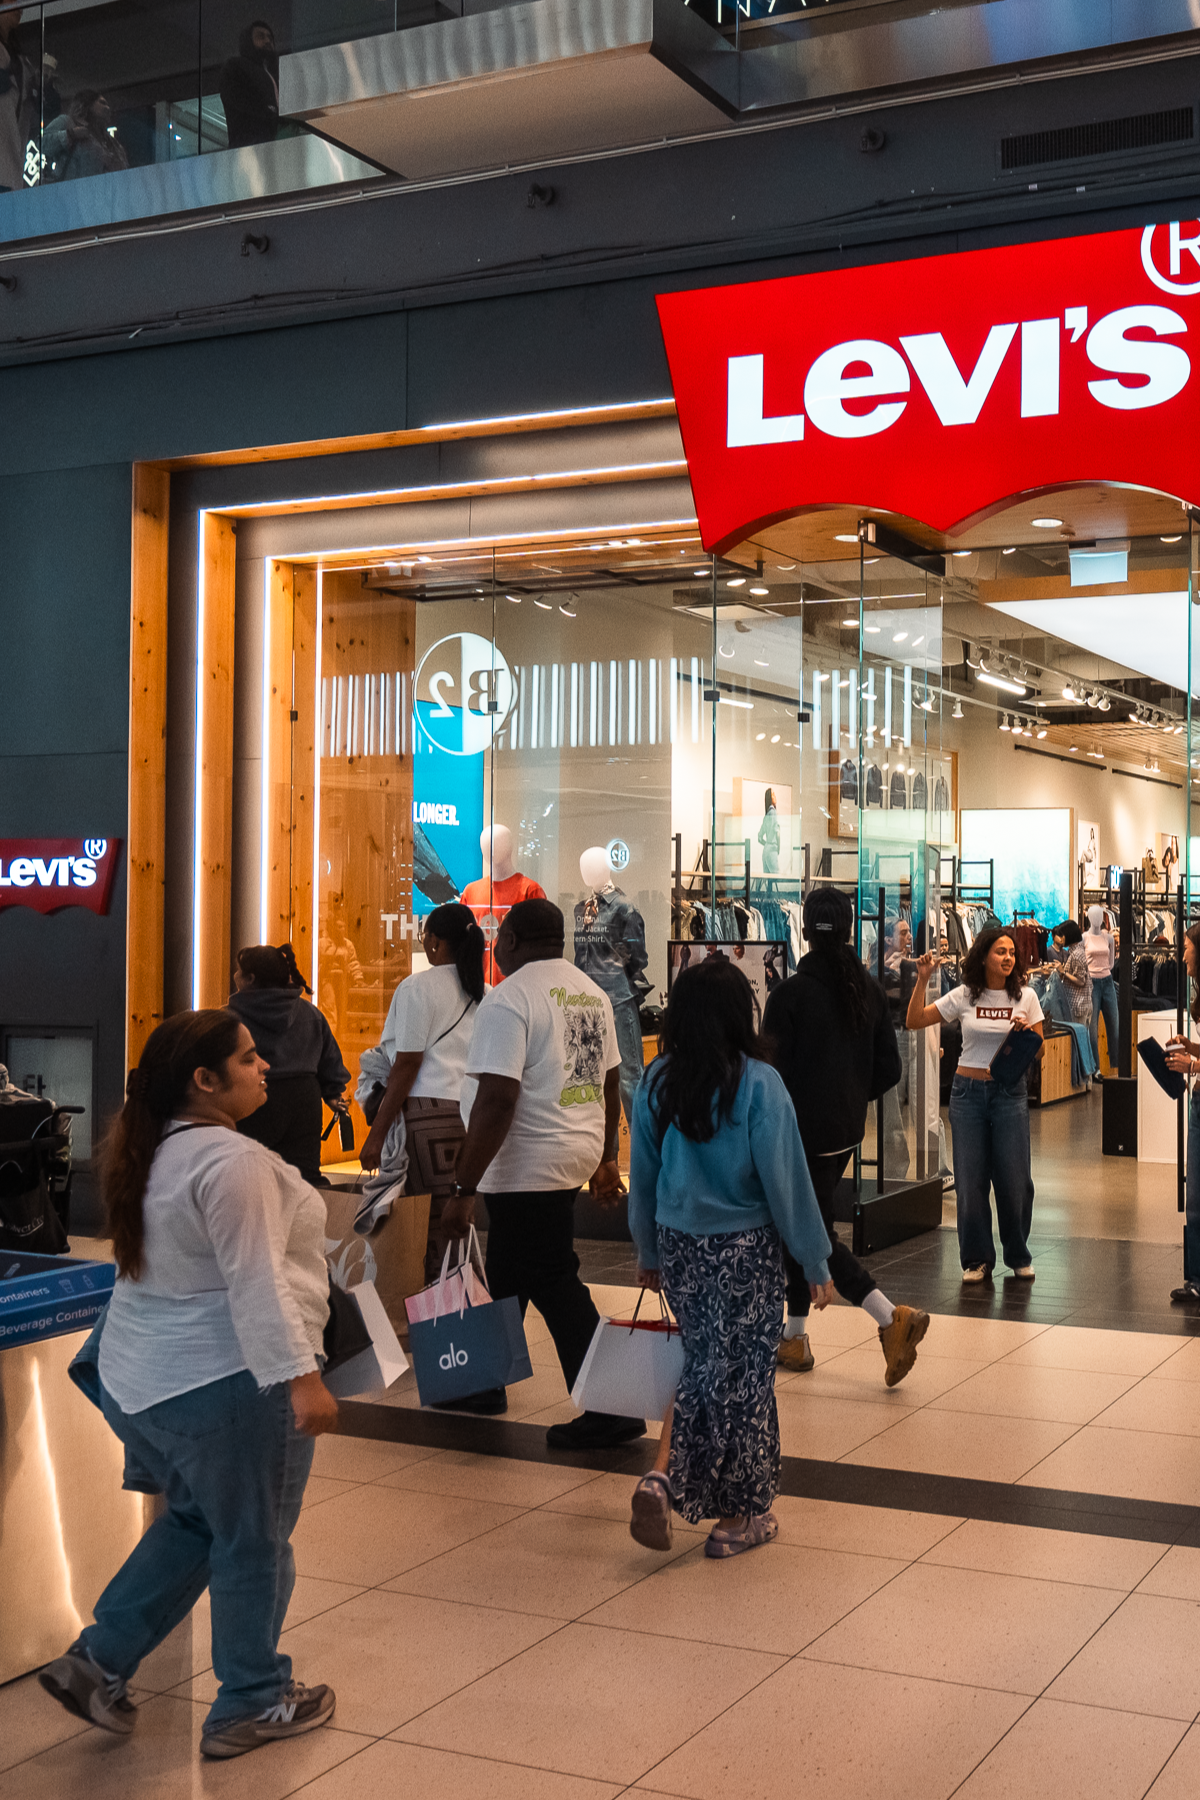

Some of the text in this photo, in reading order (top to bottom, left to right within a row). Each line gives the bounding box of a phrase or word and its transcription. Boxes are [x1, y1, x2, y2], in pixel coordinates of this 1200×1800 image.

[0, 1286, 50, 1304] ontainers
[0, 1303, 105, 1336] Beverage Containe
[439, 1342, 469, 1371] alo
